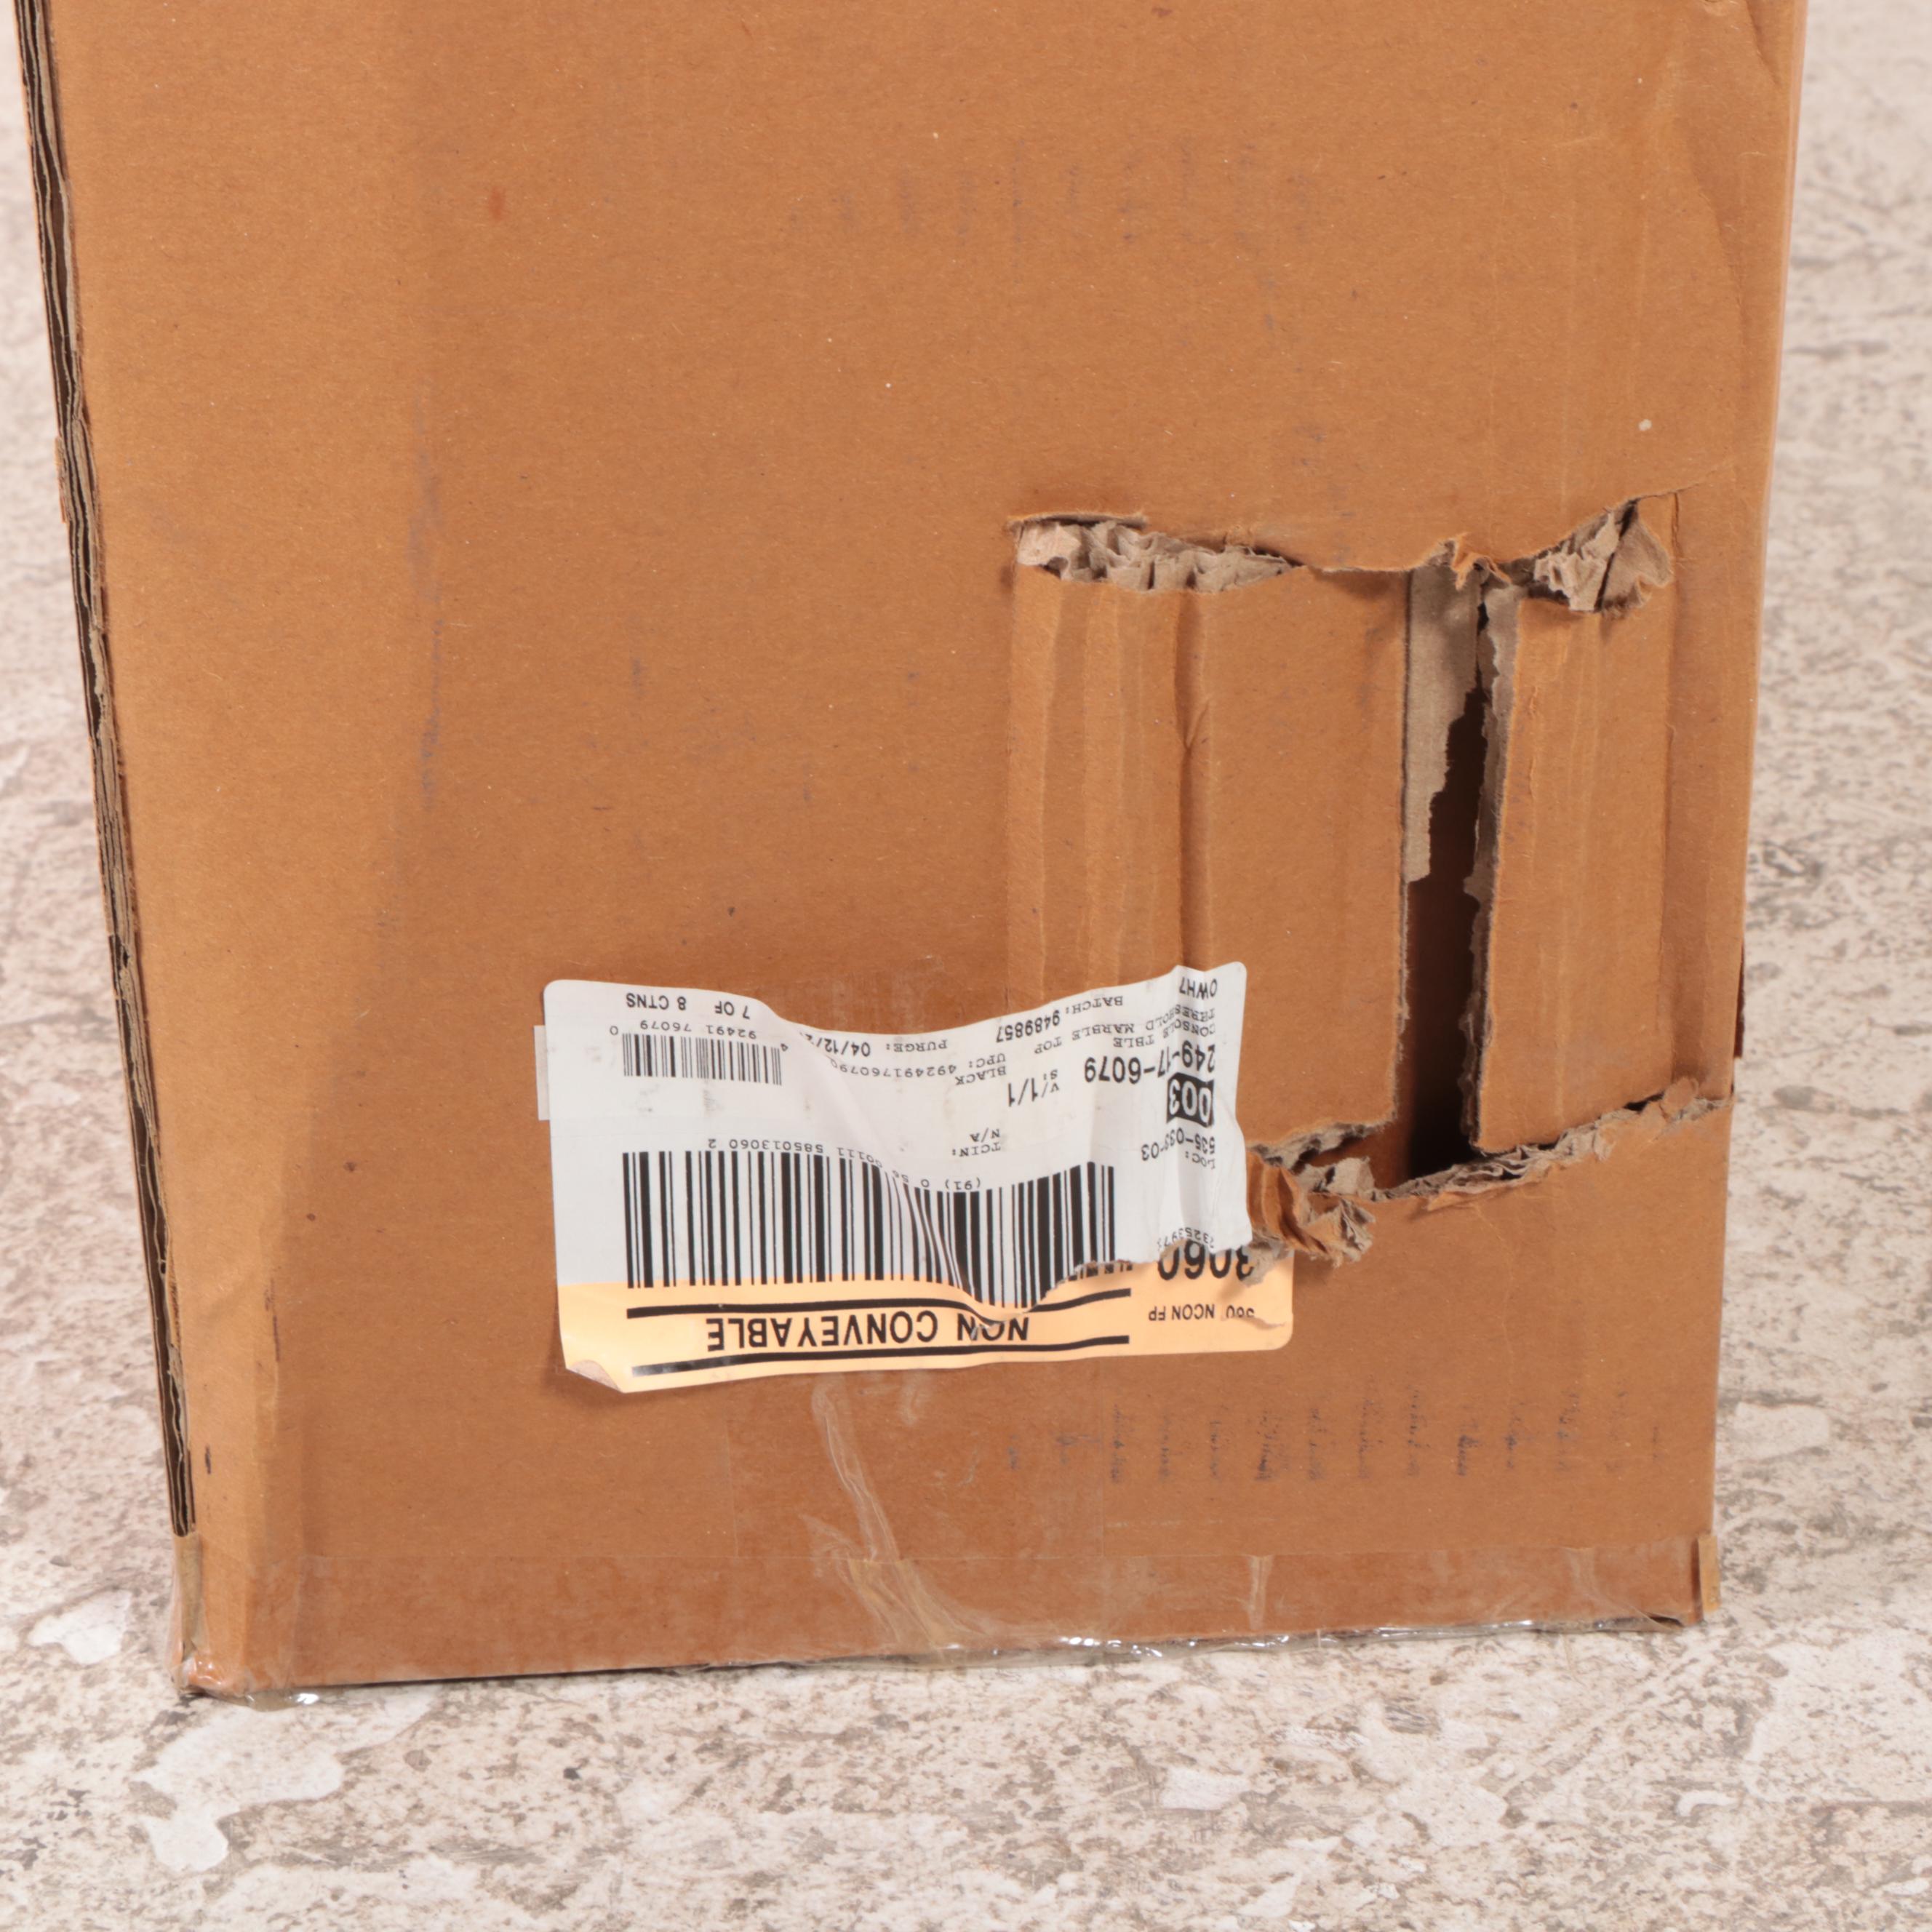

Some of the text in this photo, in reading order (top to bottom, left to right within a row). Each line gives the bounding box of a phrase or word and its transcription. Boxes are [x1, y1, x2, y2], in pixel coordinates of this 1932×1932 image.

[626, 991, 751, 1020] 7 OF 8 CTNS
[639, 1020, 692, 1032] 76079
[994, 994, 1124, 1043] BATCH: 9489857
[706, 1024, 757, 1039] 92491
[1033, 1003, 1216, 1055] THRESHOLD MARBLE TOP
[1111, 1018, 1216, 1047] CONSOLE TBLE
[780, 1043, 789, 1052] 4
[885, 1038, 948, 1053] PURGE:
[828, 1053, 1006, 1078] UPC: 492491760790
[1083, 1039, 1216, 1085] 249-17-6079
[954, 1065, 1006, 1086] BLACK
[1168, 1079, 1212, 1123] 003
[707, 1138, 716, 1149] 2
[969, 1127, 1001, 1143] N/A
[728, 1138, 824, 1154] 585013060
[951, 1141, 1001, 1157] TCIN:
[1185, 1151, 1216, 1170] LOC:
[944, 1178, 981, 1191] (91)
[1157, 1238, 1254, 1282] 3060
[1148, 1306, 1167, 1322] FP
[1171, 1304, 1216, 1321] NCON
[706, 1310, 1029, 1352] NON CONVEYABLE
